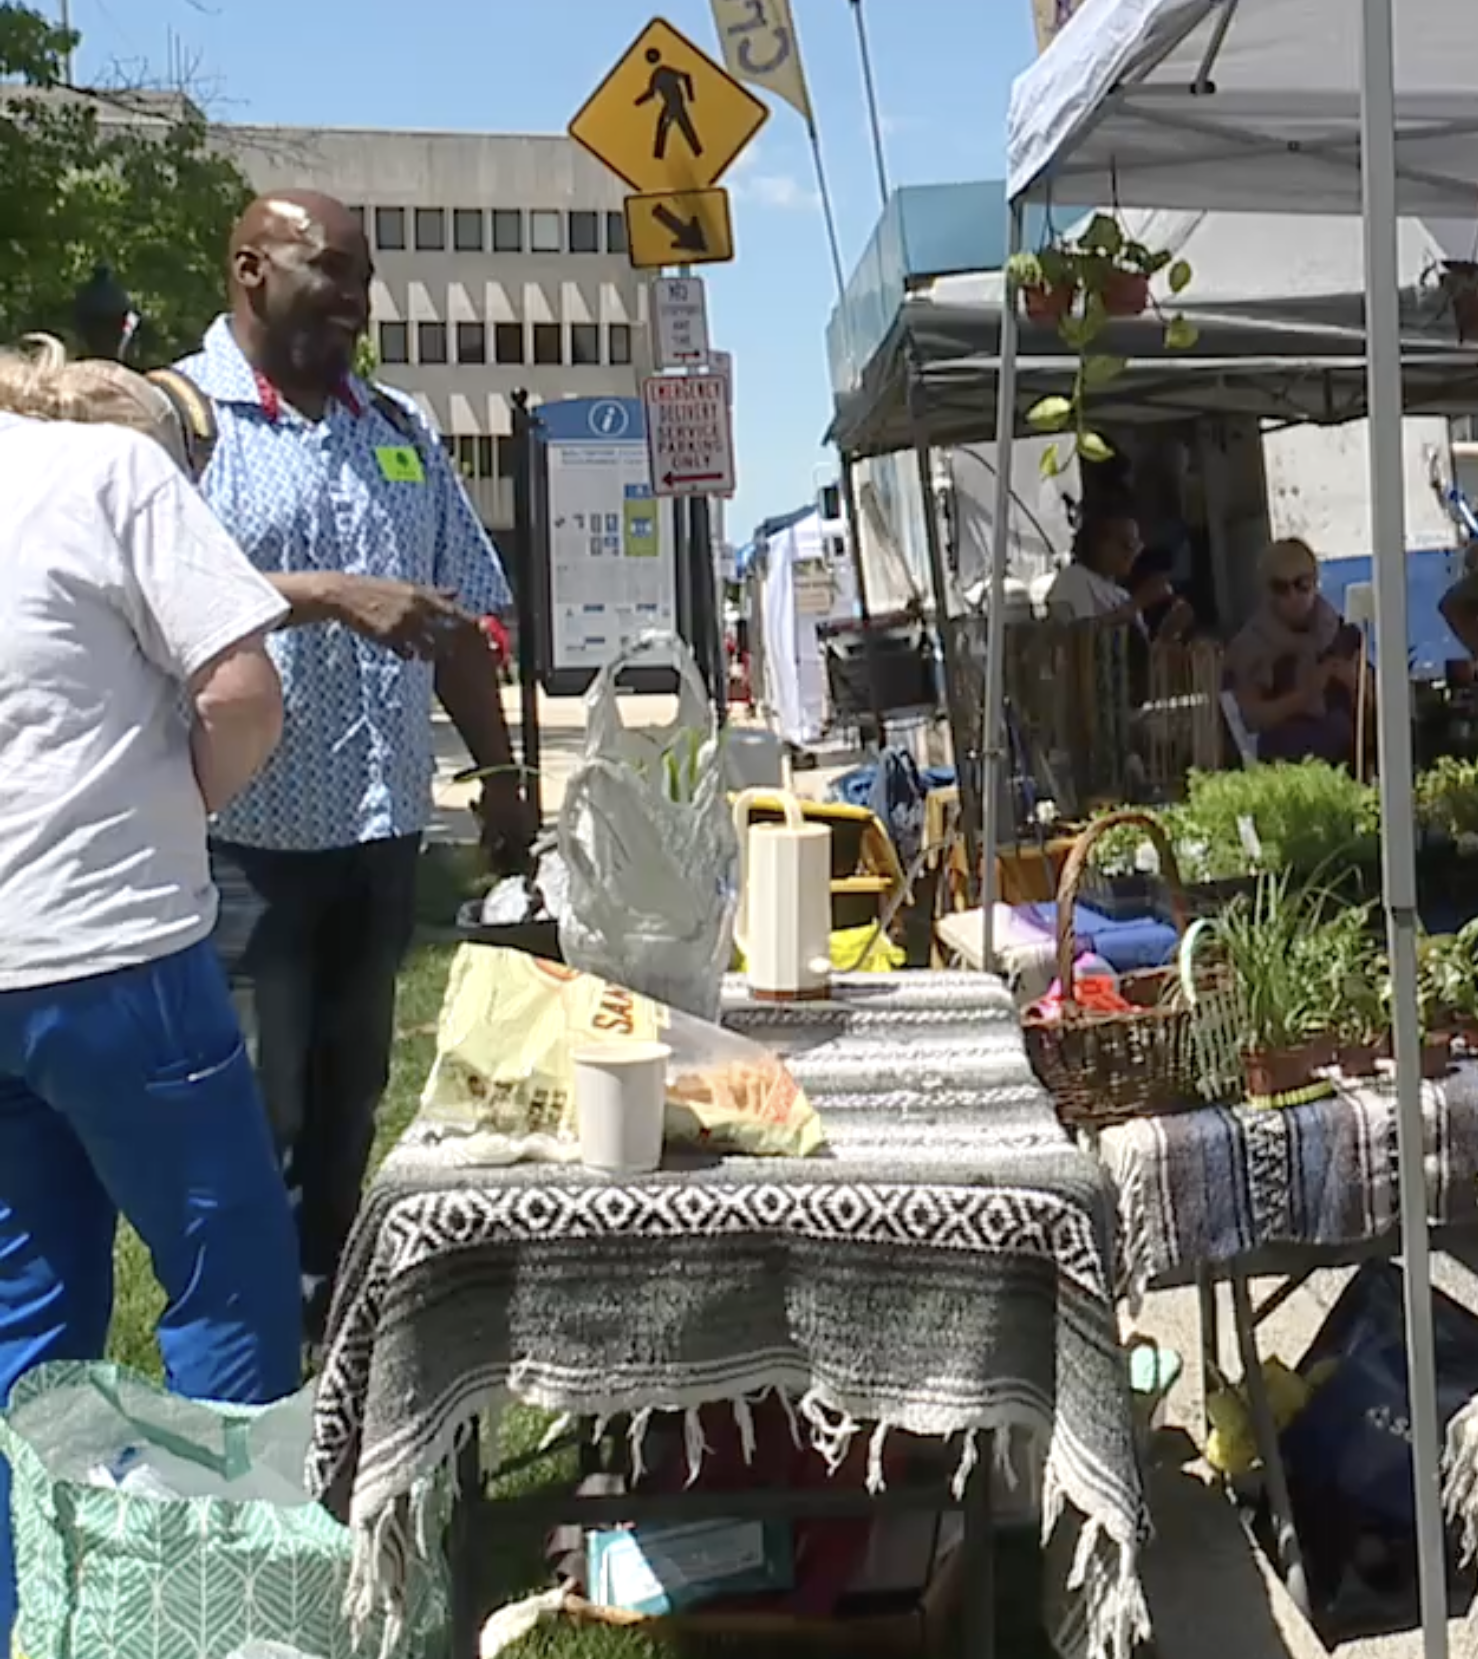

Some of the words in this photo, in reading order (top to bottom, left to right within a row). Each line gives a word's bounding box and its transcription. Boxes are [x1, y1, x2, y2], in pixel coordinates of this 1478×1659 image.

[651, 381, 720, 403] EMERGENCY
[660, 402, 717, 422] DELIVERY
[657, 422, 717, 441] SERVICE
[658, 440, 724, 454] PARKING
[671, 455, 710, 471] ONLY
